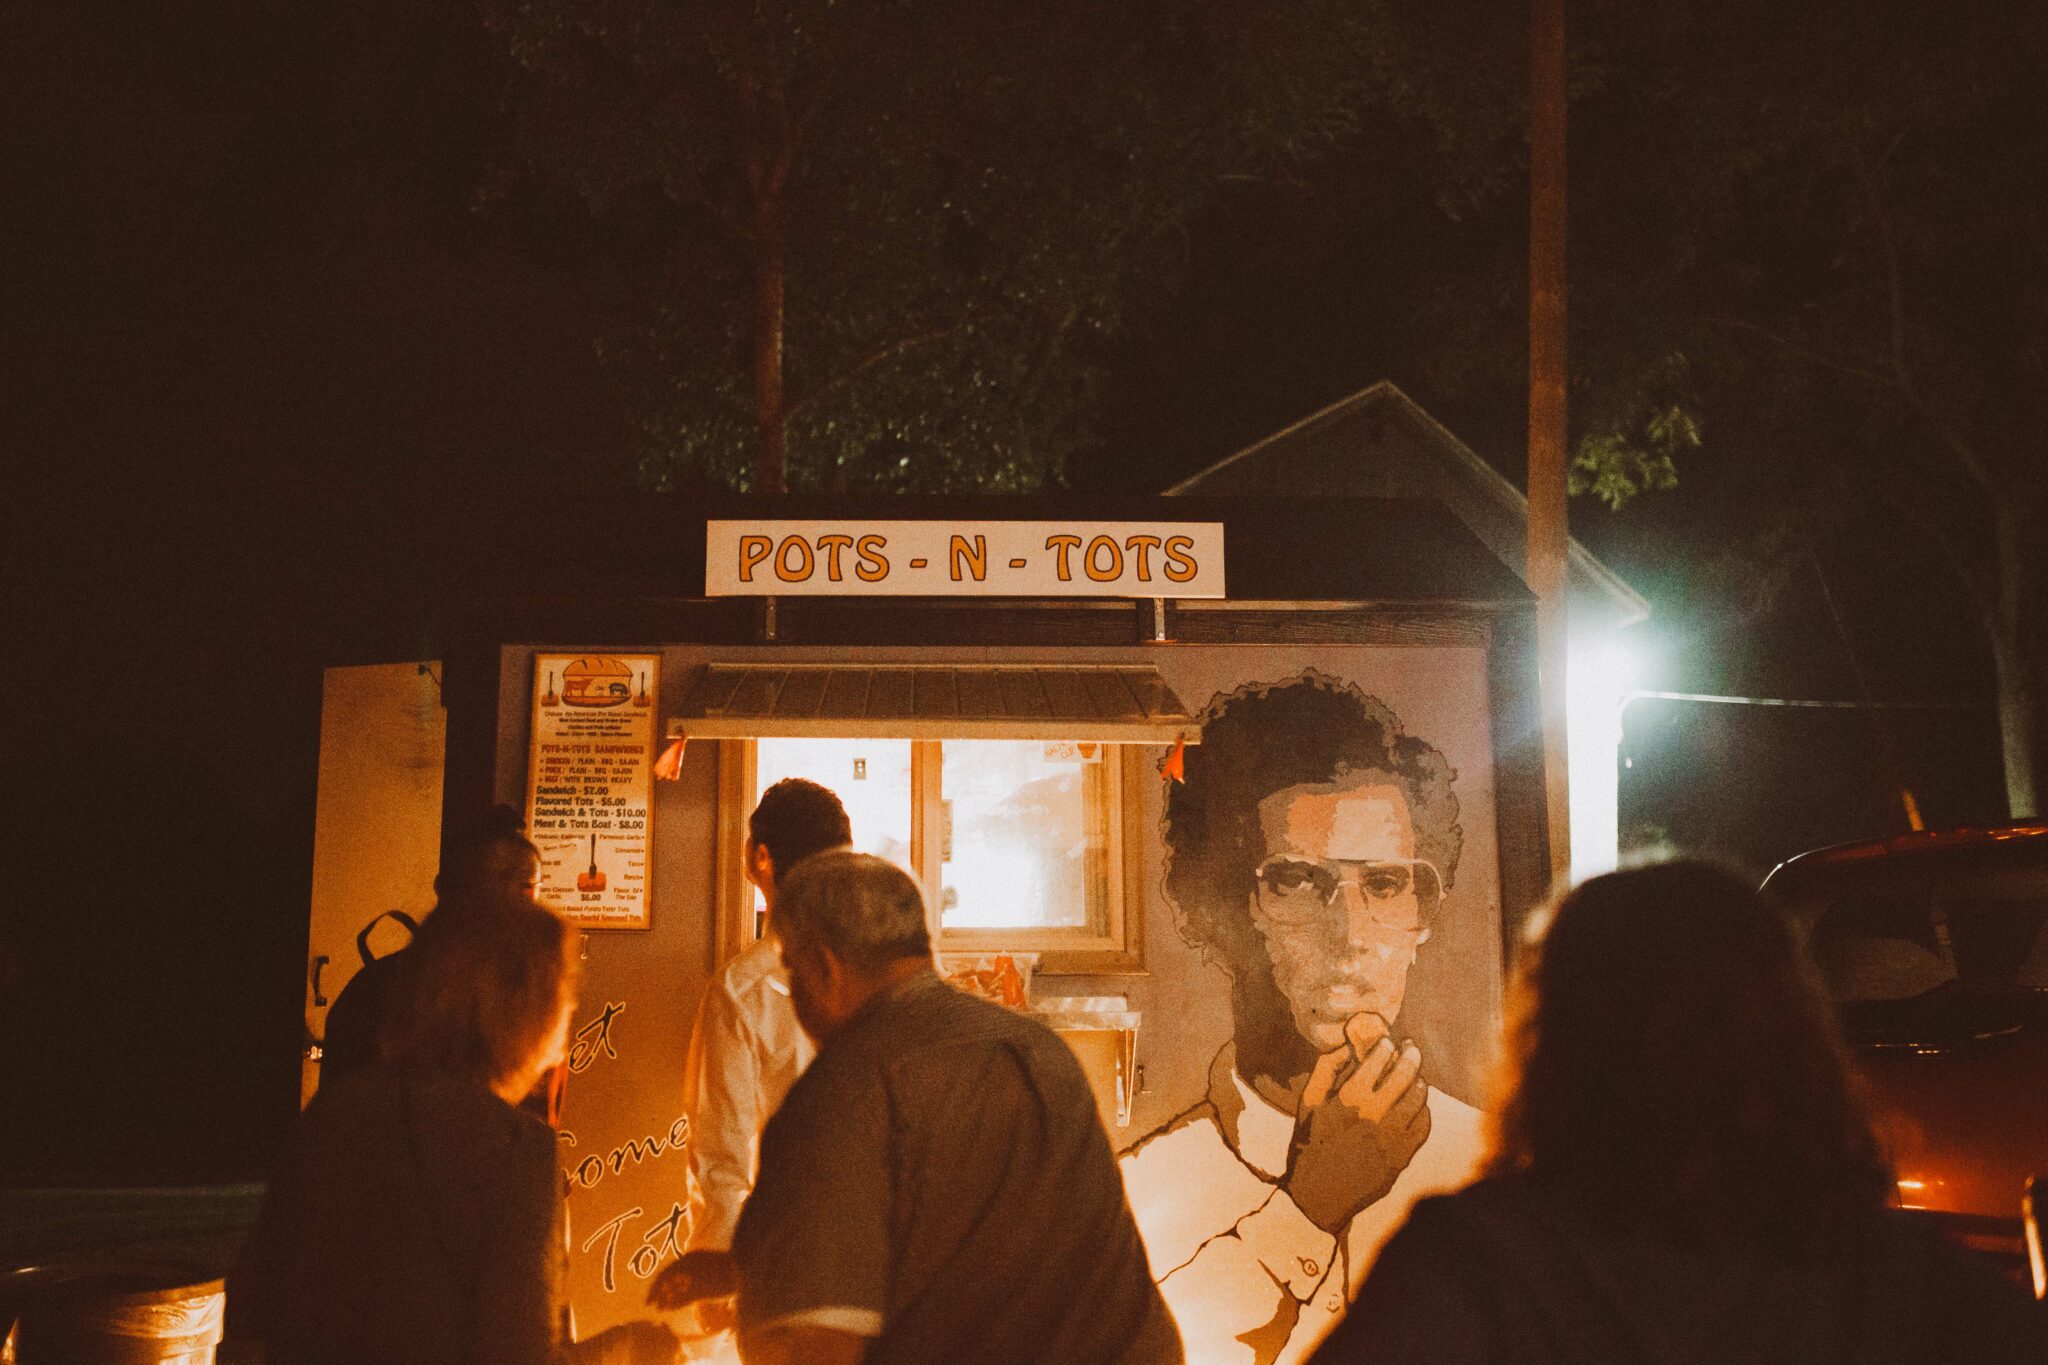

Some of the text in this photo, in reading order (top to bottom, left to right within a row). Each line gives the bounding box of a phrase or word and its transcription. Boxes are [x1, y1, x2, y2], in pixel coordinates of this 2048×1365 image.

[739, 534, 890, 583] POTS
[950, 534, 987, 582] N
[1045, 534, 1198, 583] TOTS
[536, 786, 576, 795] Sandwich
[536, 796, 572, 805] Flavored
[574, 797, 594, 805] Tots
[535, 808, 575, 816] Sandwich
[578, 808, 586, 817] &
[589, 808, 609, 817] Tots
[616, 809, 646, 817] $10.00
[534, 819, 555, 828] Meat
[558, 819, 567, 828] &
[569, 820, 589, 828] Tots
[592, 820, 612, 828] Boat
[569, 1001, 626, 1075] et
